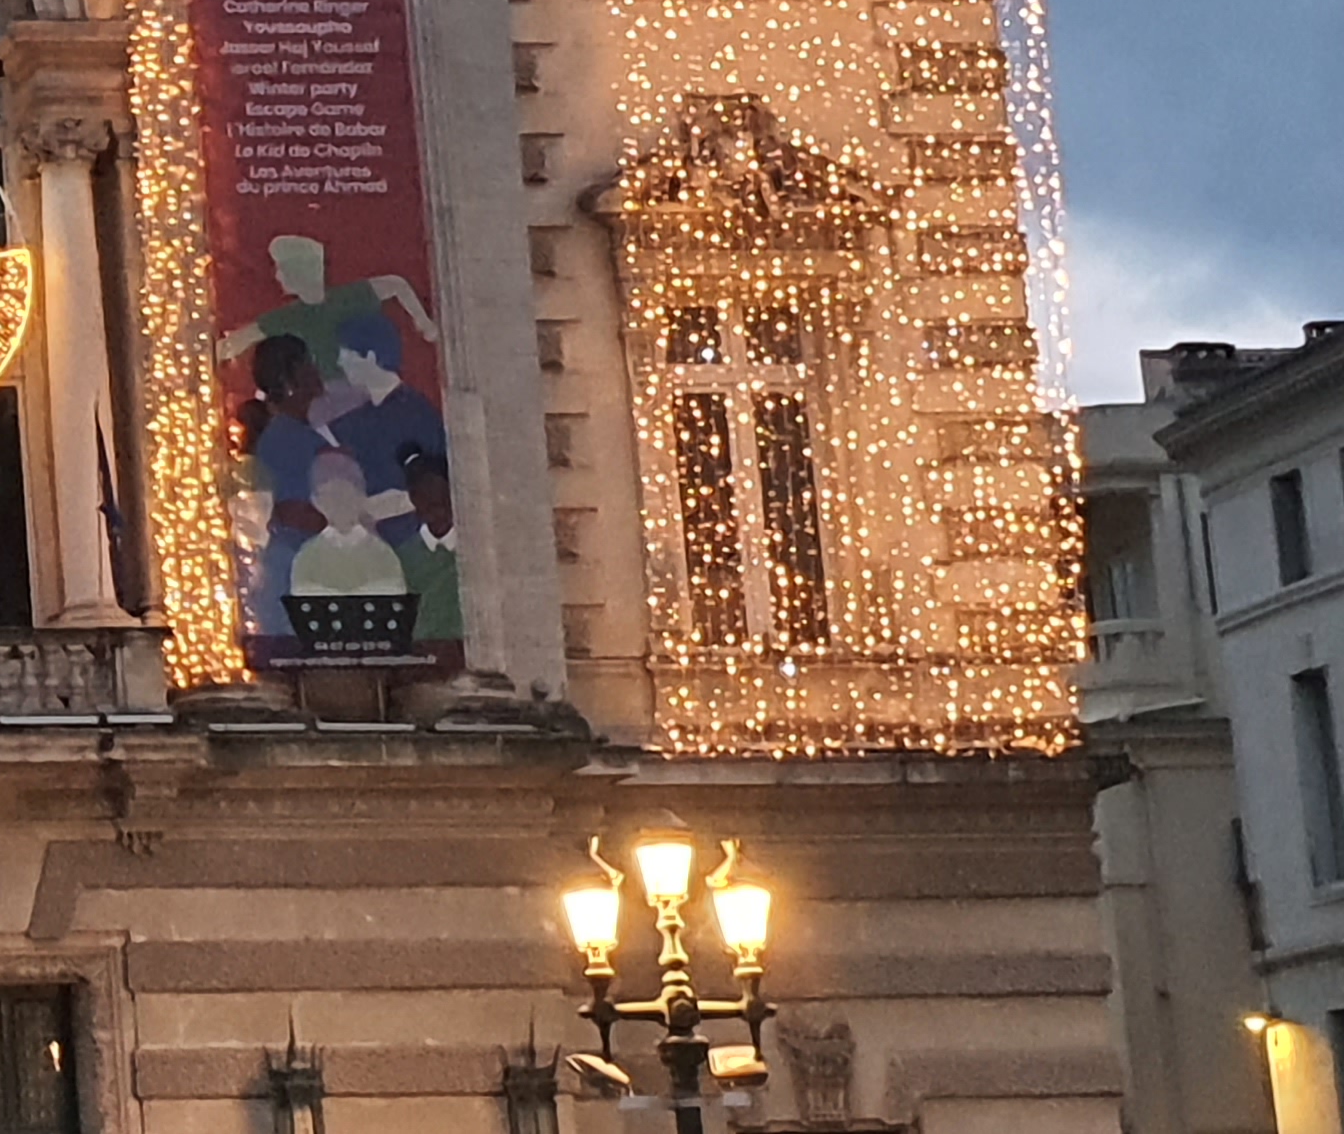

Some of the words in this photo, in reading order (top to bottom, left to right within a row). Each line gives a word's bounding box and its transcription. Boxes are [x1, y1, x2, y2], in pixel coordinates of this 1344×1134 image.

[309, 83, 358, 99] party
[245, 102, 308, 118] Escape
[311, 101, 365, 116] Game
[309, 123, 332, 136] de
[334, 122, 387, 137] Babar
[257, 143, 285, 158] Kid
[288, 143, 311, 158] de
[314, 142, 383, 161] Chaplin
[249, 165, 278, 179] Les
[236, 179, 260, 193] du
